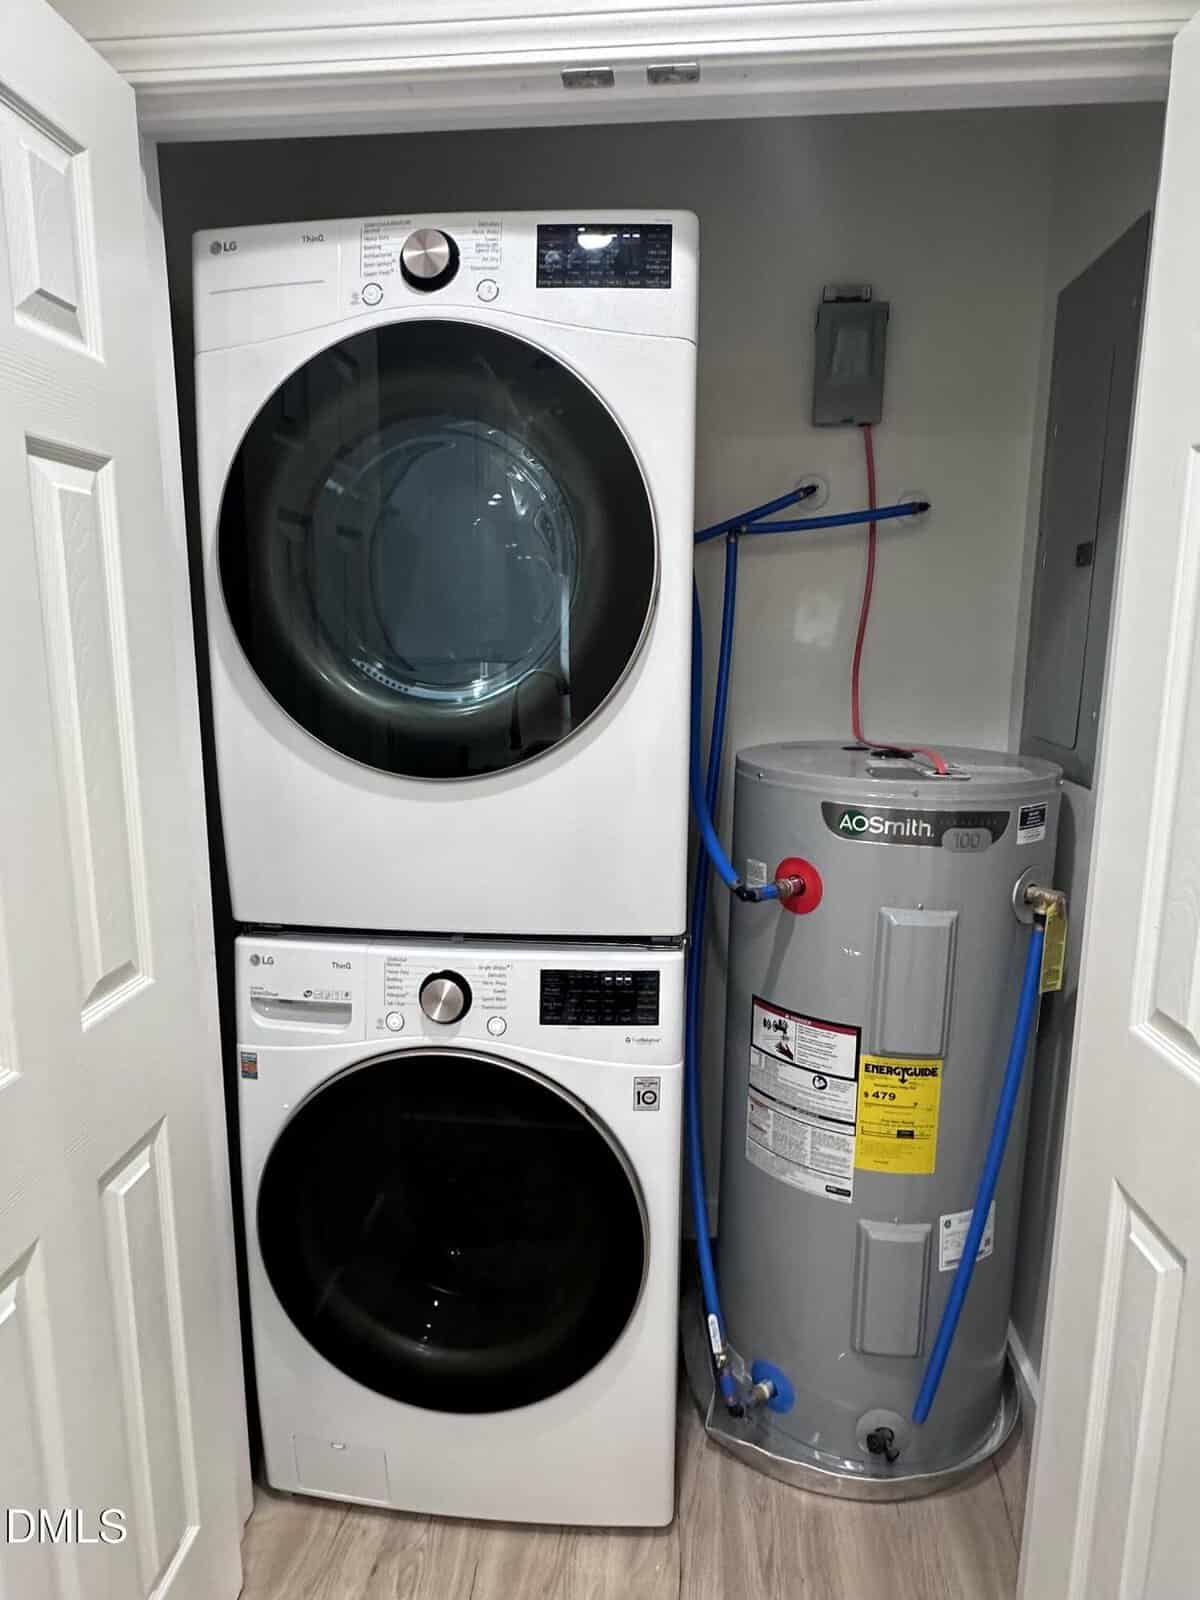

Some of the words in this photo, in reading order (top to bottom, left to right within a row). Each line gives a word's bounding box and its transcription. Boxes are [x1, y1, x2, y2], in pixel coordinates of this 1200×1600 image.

[223, 240, 237, 252] LG
[262, 956, 275, 966] LG
[331, 961, 352, 970] ThinQ
[871, 1090, 897, 1101] 479
